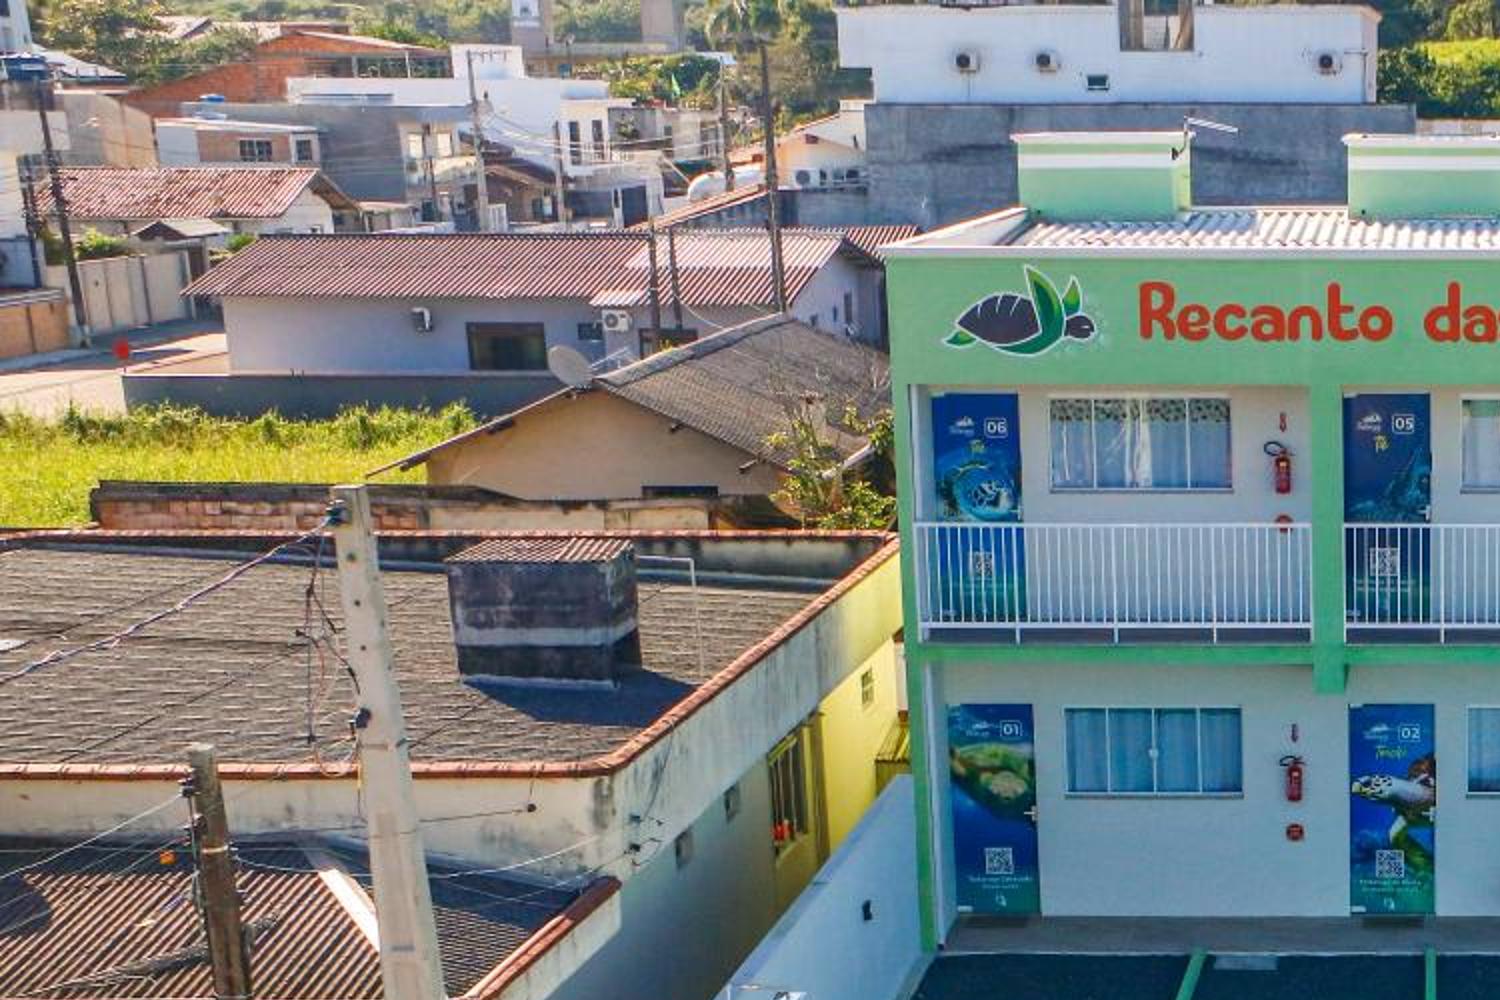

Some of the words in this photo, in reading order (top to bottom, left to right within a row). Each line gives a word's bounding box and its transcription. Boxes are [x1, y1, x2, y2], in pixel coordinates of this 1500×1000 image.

[1138, 281, 1394, 342] Recanto
[987, 421, 1008, 434] 06
[1395, 417, 1414, 430] 05
[1003, 723, 1019, 735] 01
[1401, 727, 1421, 739] 02
